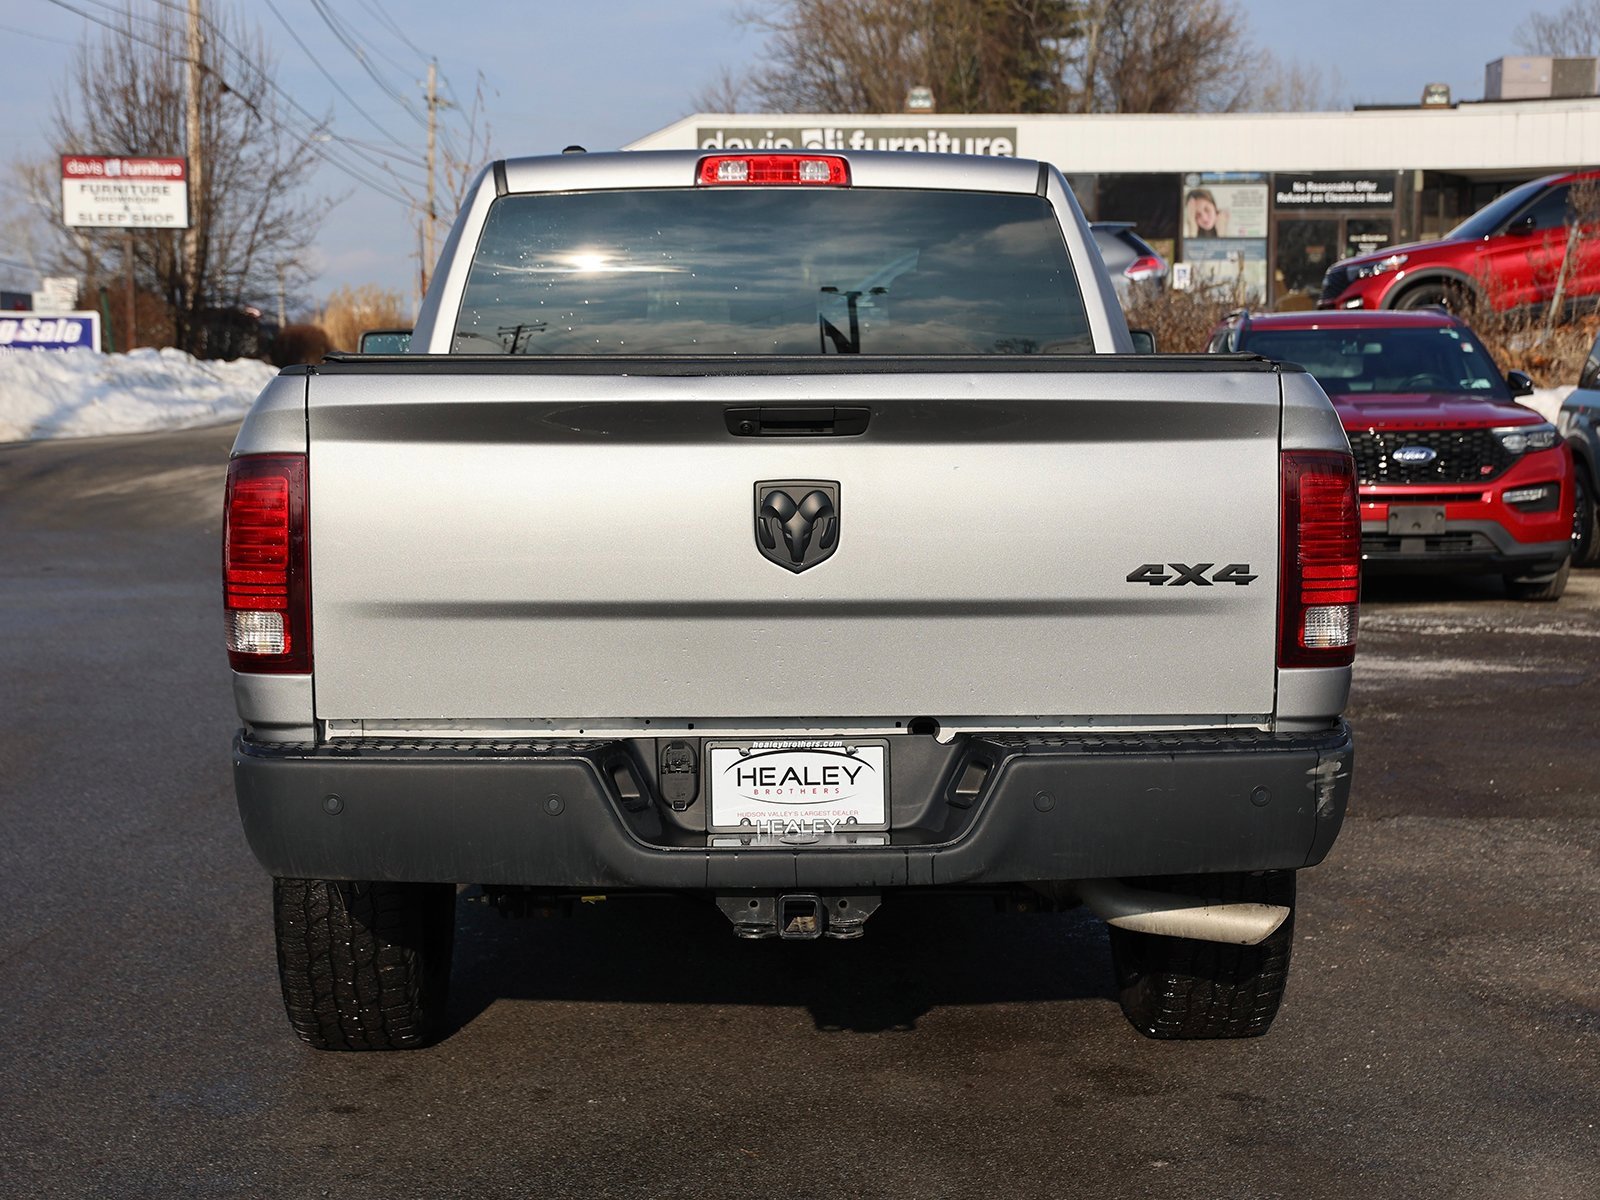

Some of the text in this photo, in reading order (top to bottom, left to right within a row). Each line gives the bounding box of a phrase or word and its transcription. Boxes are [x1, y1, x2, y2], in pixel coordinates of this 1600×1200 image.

[849, 130, 1014, 158] furniture
[66, 159, 183, 176] davis furniture
[80, 184, 171, 196] FURNITURE
[1293, 181, 1378, 192] No Reasonable Offer
[1277, 192, 1312, 203] Refused
[1312, 193, 1324, 203] on
[1324, 192, 1366, 203] Clearance
[78, 213, 174, 224] SLEEP SHOP
[1126, 563, 1259, 586] 4X4
[752, 740, 843, 750] healeybrothers.com
[737, 765, 862, 787] HEALEY
[753, 787, 840, 796] BROTHERS
[767, 810, 799, 818] VALLEY'S
[832, 809, 859, 817] DEALER
[756, 818, 841, 834] HEALEY
